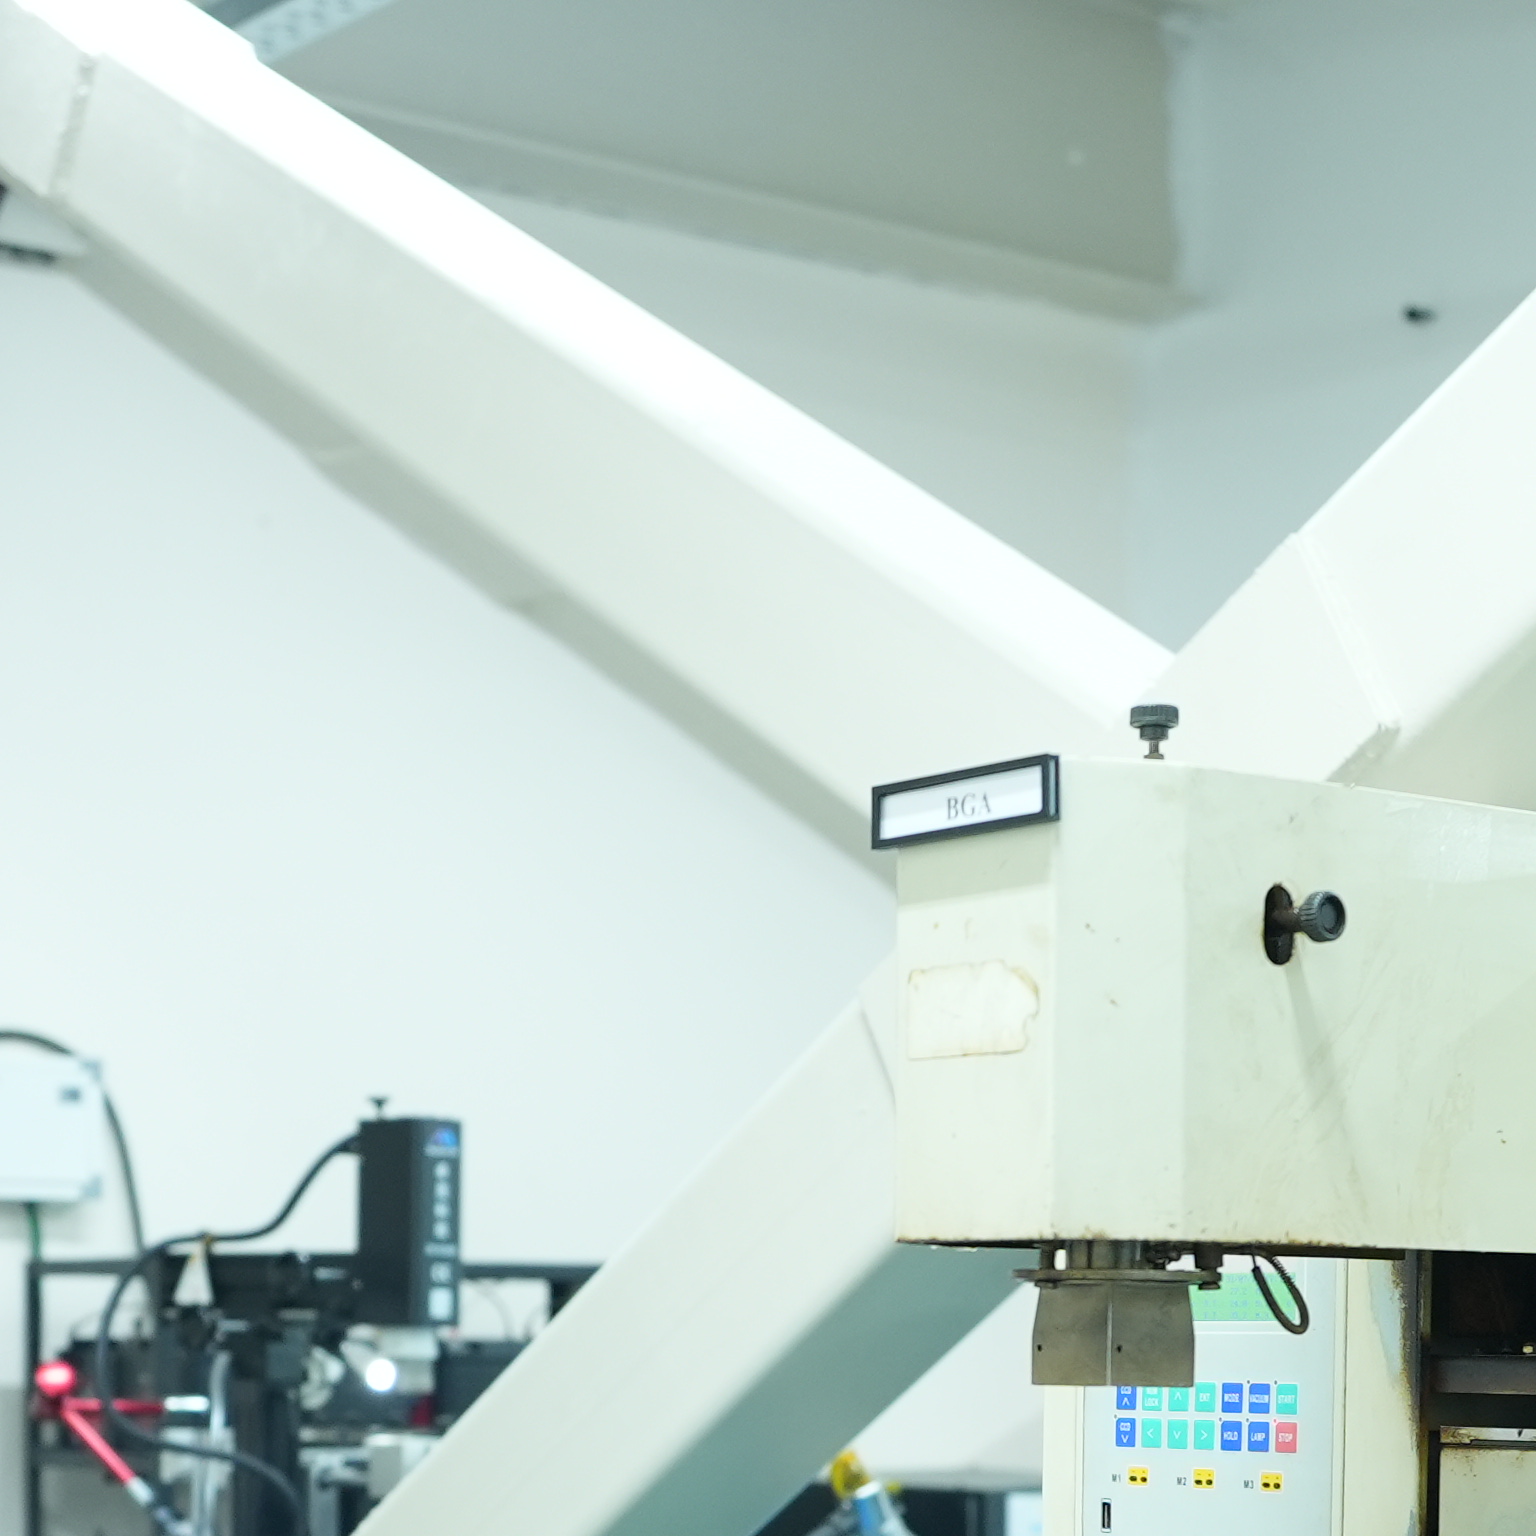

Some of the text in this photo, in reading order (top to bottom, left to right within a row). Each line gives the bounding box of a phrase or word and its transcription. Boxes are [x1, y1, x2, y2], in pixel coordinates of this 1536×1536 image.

[947, 791, 991, 820] BGA
[1277, 1395, 1295, 1404] START
[1223, 1431, 1239, 1441] HOLD
[1250, 1432, 1266, 1442] LAMP
[1278, 1433, 1293, 1443] STOP
